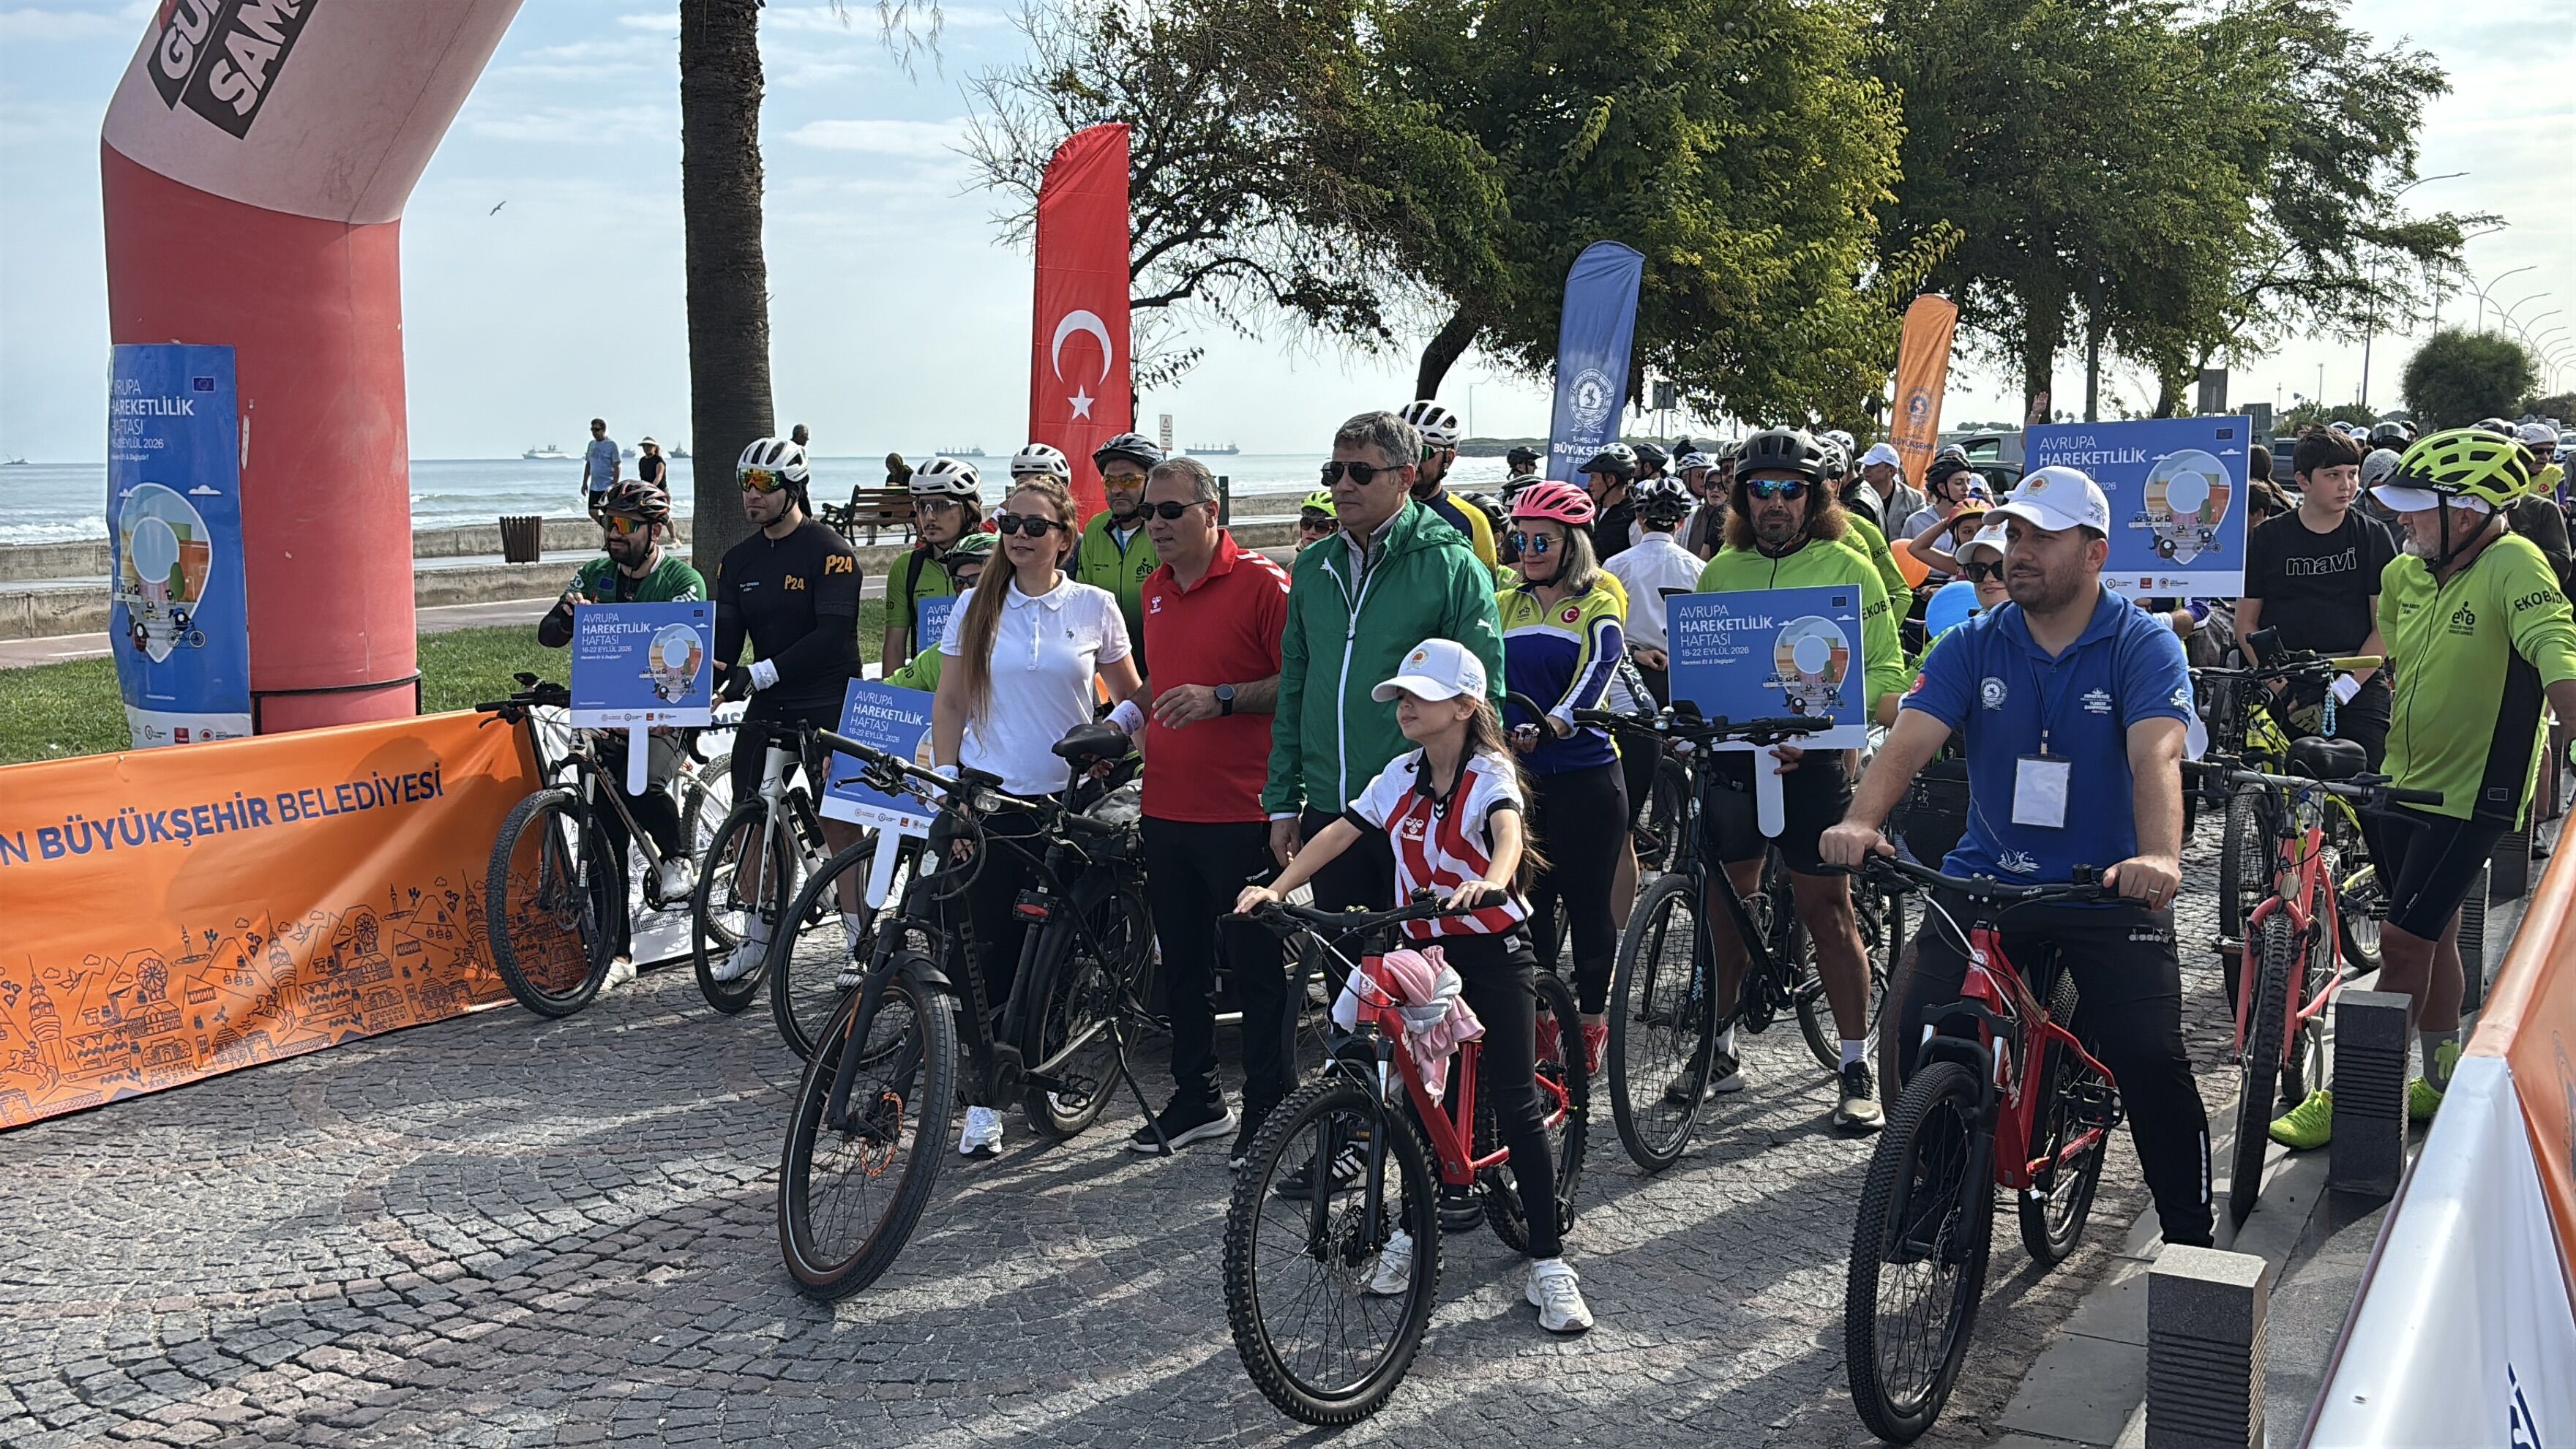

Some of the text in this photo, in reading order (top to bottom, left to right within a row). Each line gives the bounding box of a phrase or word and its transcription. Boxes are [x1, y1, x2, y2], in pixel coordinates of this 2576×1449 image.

[143, 438, 165, 449] 2026
[1572, 436, 1600, 444] SAMSUN
[2039, 435, 2097, 450] AVRUPA
[2039, 448, 2146, 466] HAREKETLİLİK
[2432, 484, 2458, 493] LAZER
[825, 554, 853, 576] P24
[2286, 547, 2356, 575] mavi
[784, 574, 805, 591] P24
[583, 613, 620, 624] AVRUPA
[1679, 604, 1729, 619] AVRUPA
[583, 621, 651, 634] HAREKETLİLİK
[1680, 615, 1773, 633] HAREKETLİLİK
[582, 635, 619, 645] HAFTASI
[1680, 633, 1731, 647] HAFTASI
[1682, 648, 1701, 656] 16-22
[1703, 646, 1729, 656] EYLÜL
[855, 690, 894, 707] AVRUPA
[853, 703, 924, 726] HAREKETLİLİK
[850, 714, 889, 732] HAFTASI
[37, 791, 273, 860] BÜYÜKŞEHİR
[276, 762, 445, 823] BELEDİYESİ
